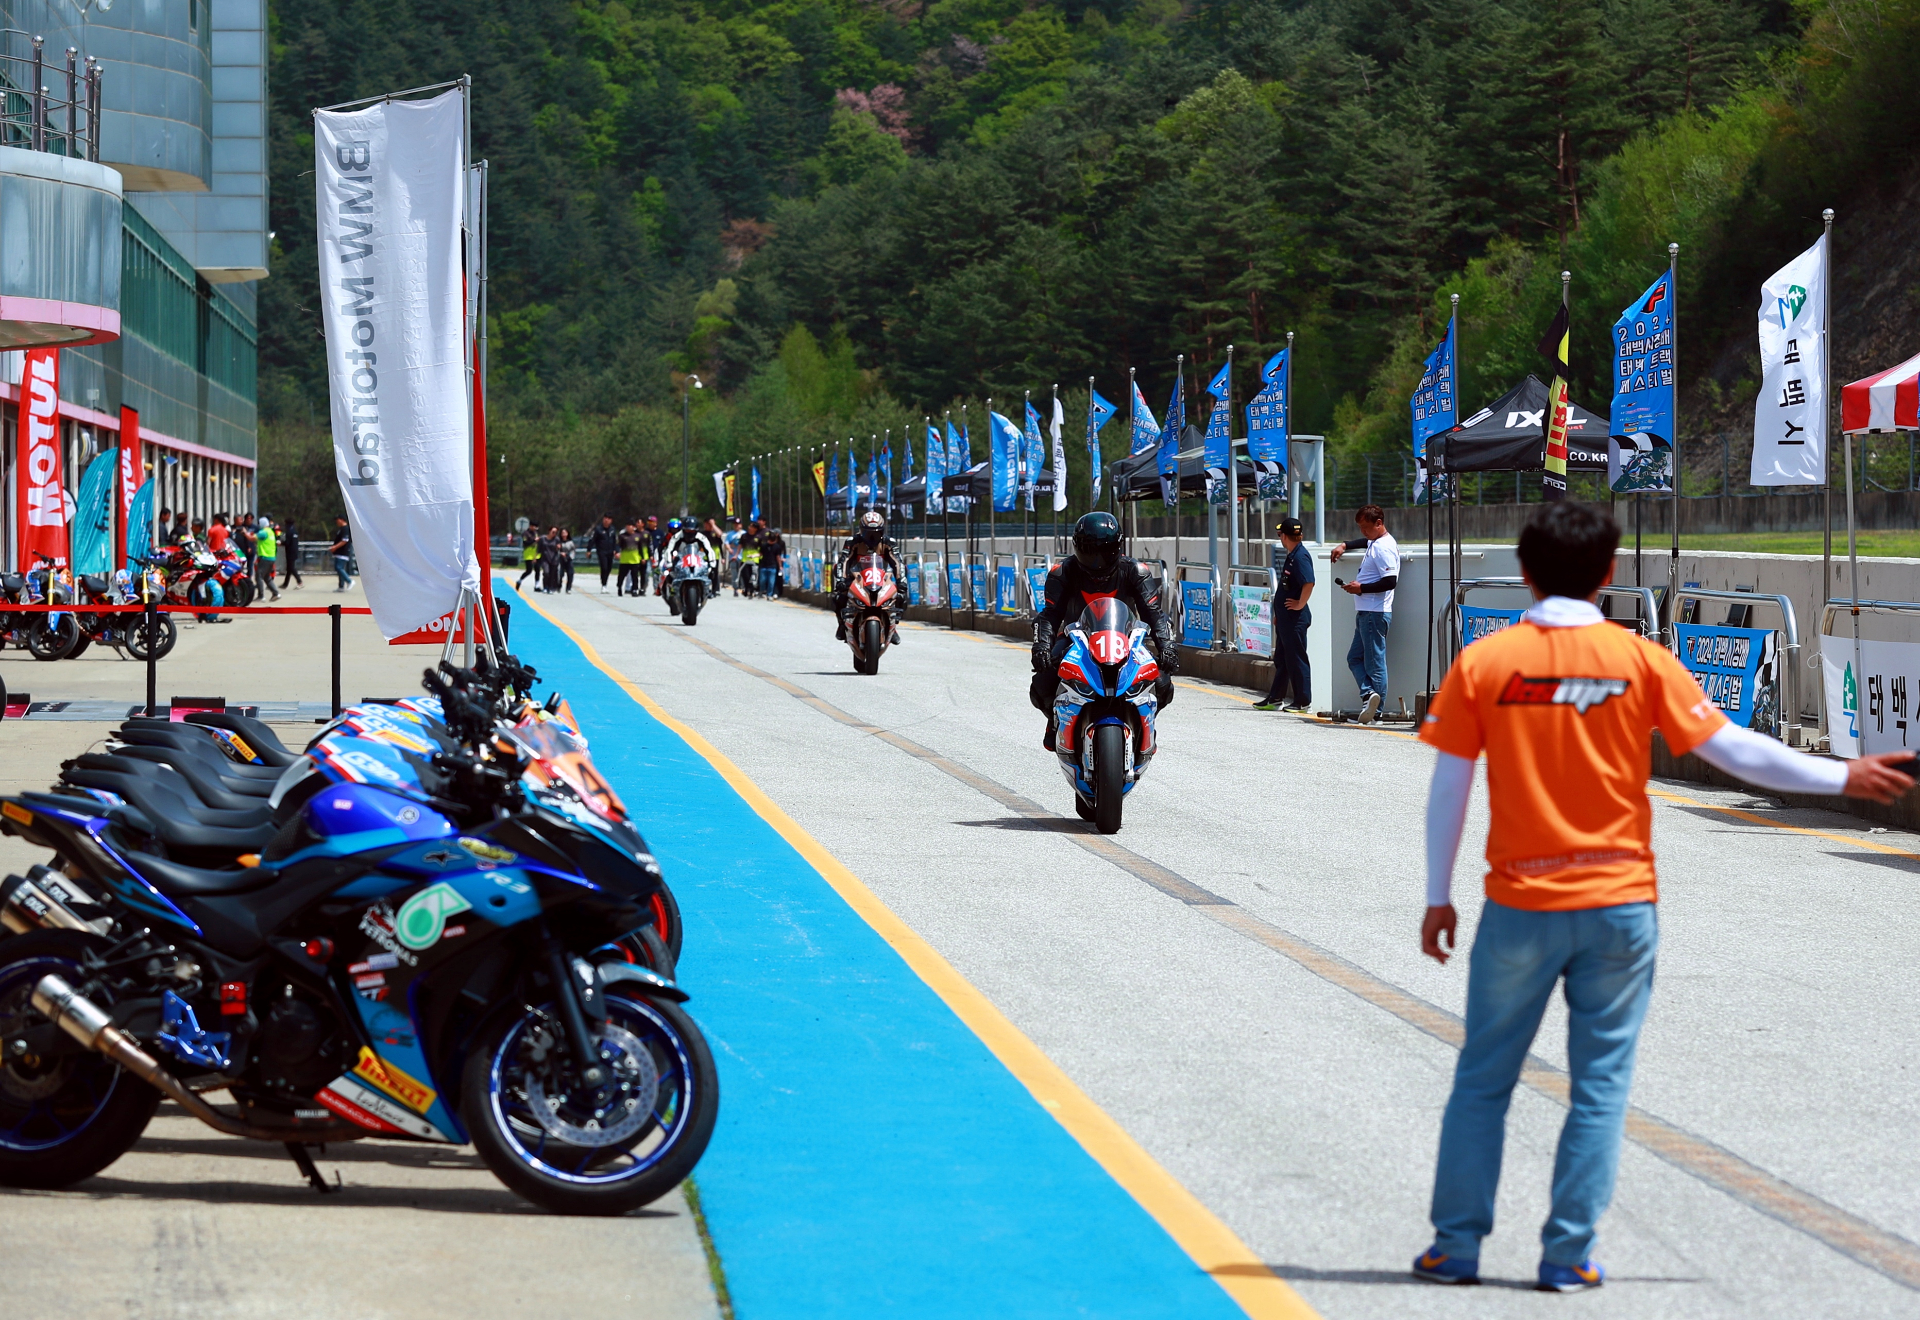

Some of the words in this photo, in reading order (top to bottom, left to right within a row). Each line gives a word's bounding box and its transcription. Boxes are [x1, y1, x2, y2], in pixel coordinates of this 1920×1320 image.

[1504, 406, 1588, 429] IXL
[28, 355, 60, 525] MOTUL
[1096, 635, 1125, 660] 18
[1696, 635, 1714, 665] 2024
[1713, 635, 1750, 670] 태백시장배
[358, 919, 419, 967] PETRONAS
[361, 1056, 428, 1106] PIRELLI
[319, 1090, 382, 1131] BARRACUDA
